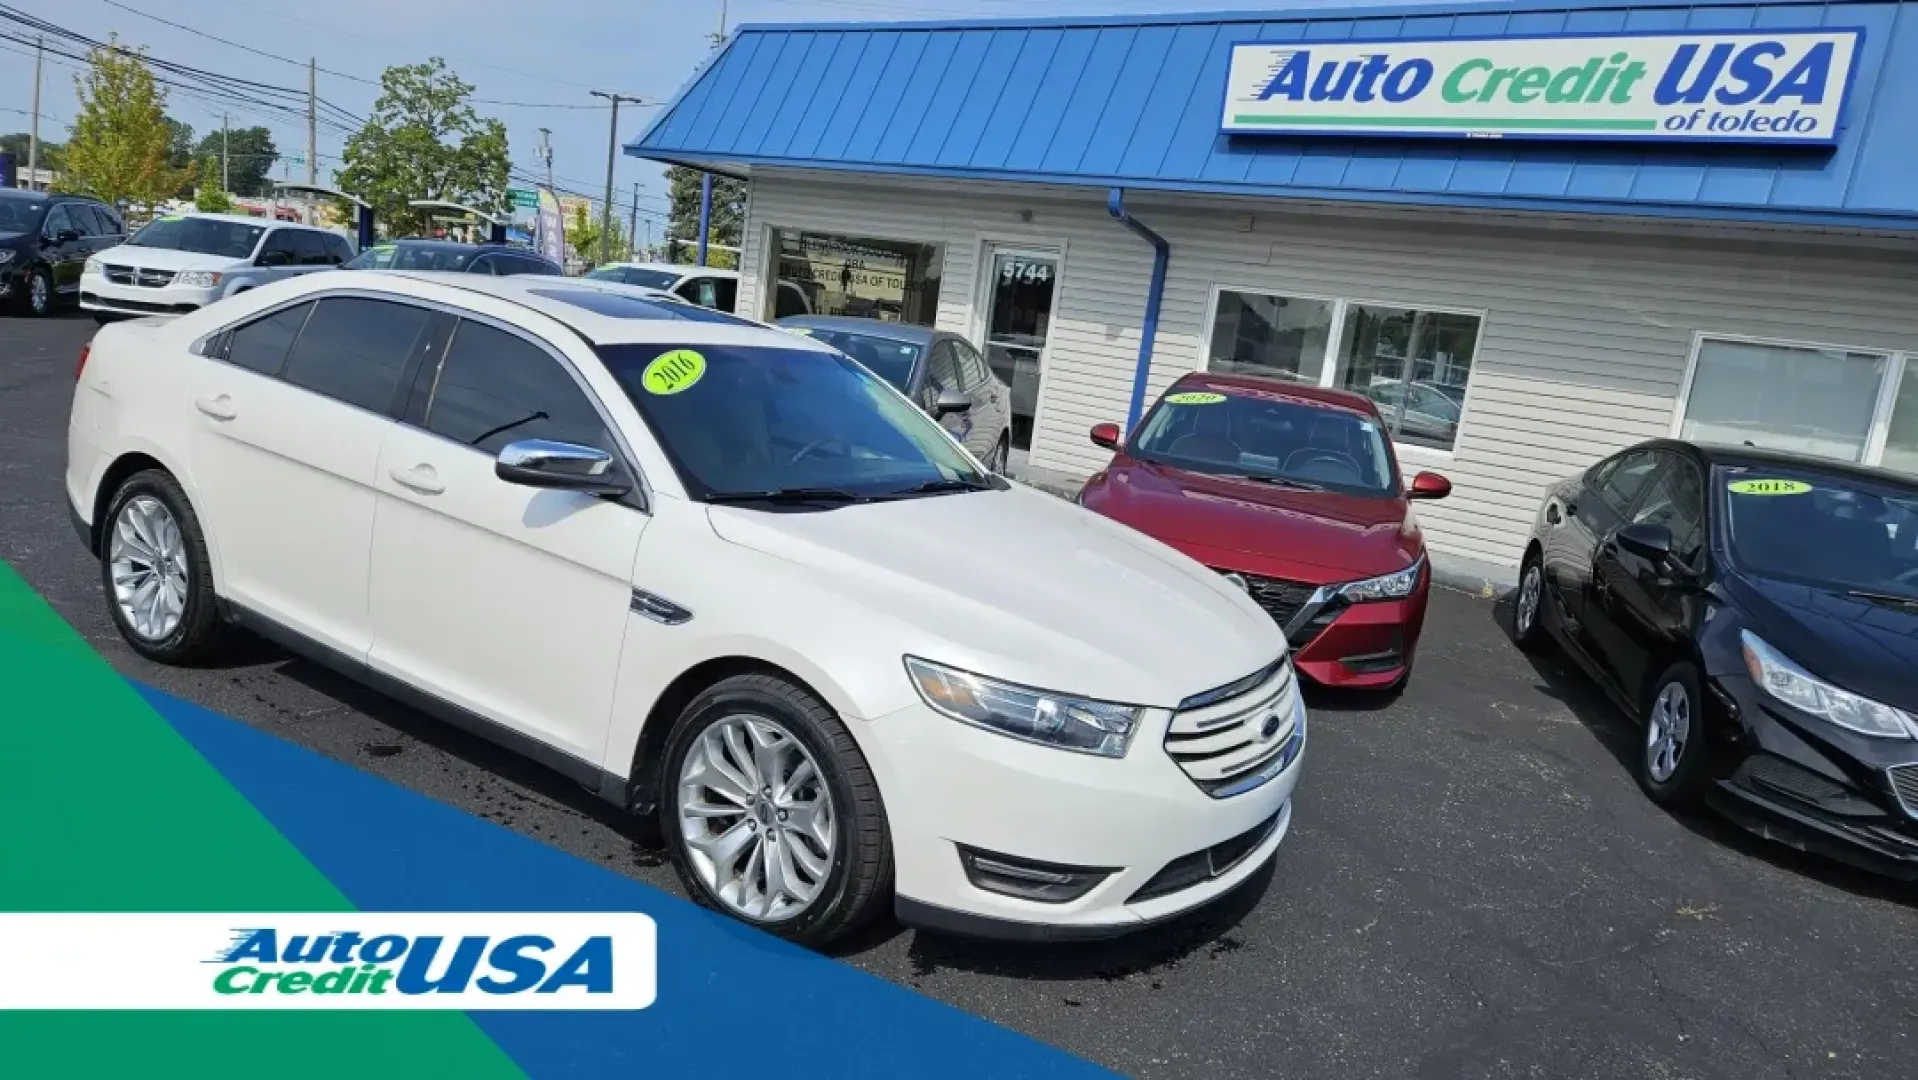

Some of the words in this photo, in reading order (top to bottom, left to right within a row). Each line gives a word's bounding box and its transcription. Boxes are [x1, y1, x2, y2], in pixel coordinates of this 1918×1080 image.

[1252, 50, 1434, 103] Auto
[1441, 52, 1647, 104] Credit
[1653, 41, 1835, 105] USA
[1664, 108, 1706, 131] of
[1707, 109, 1818, 132] toledo
[1003, 262, 1047, 281] 5744
[653, 353, 695, 390] 2016
[1747, 482, 1795, 492] 2018
